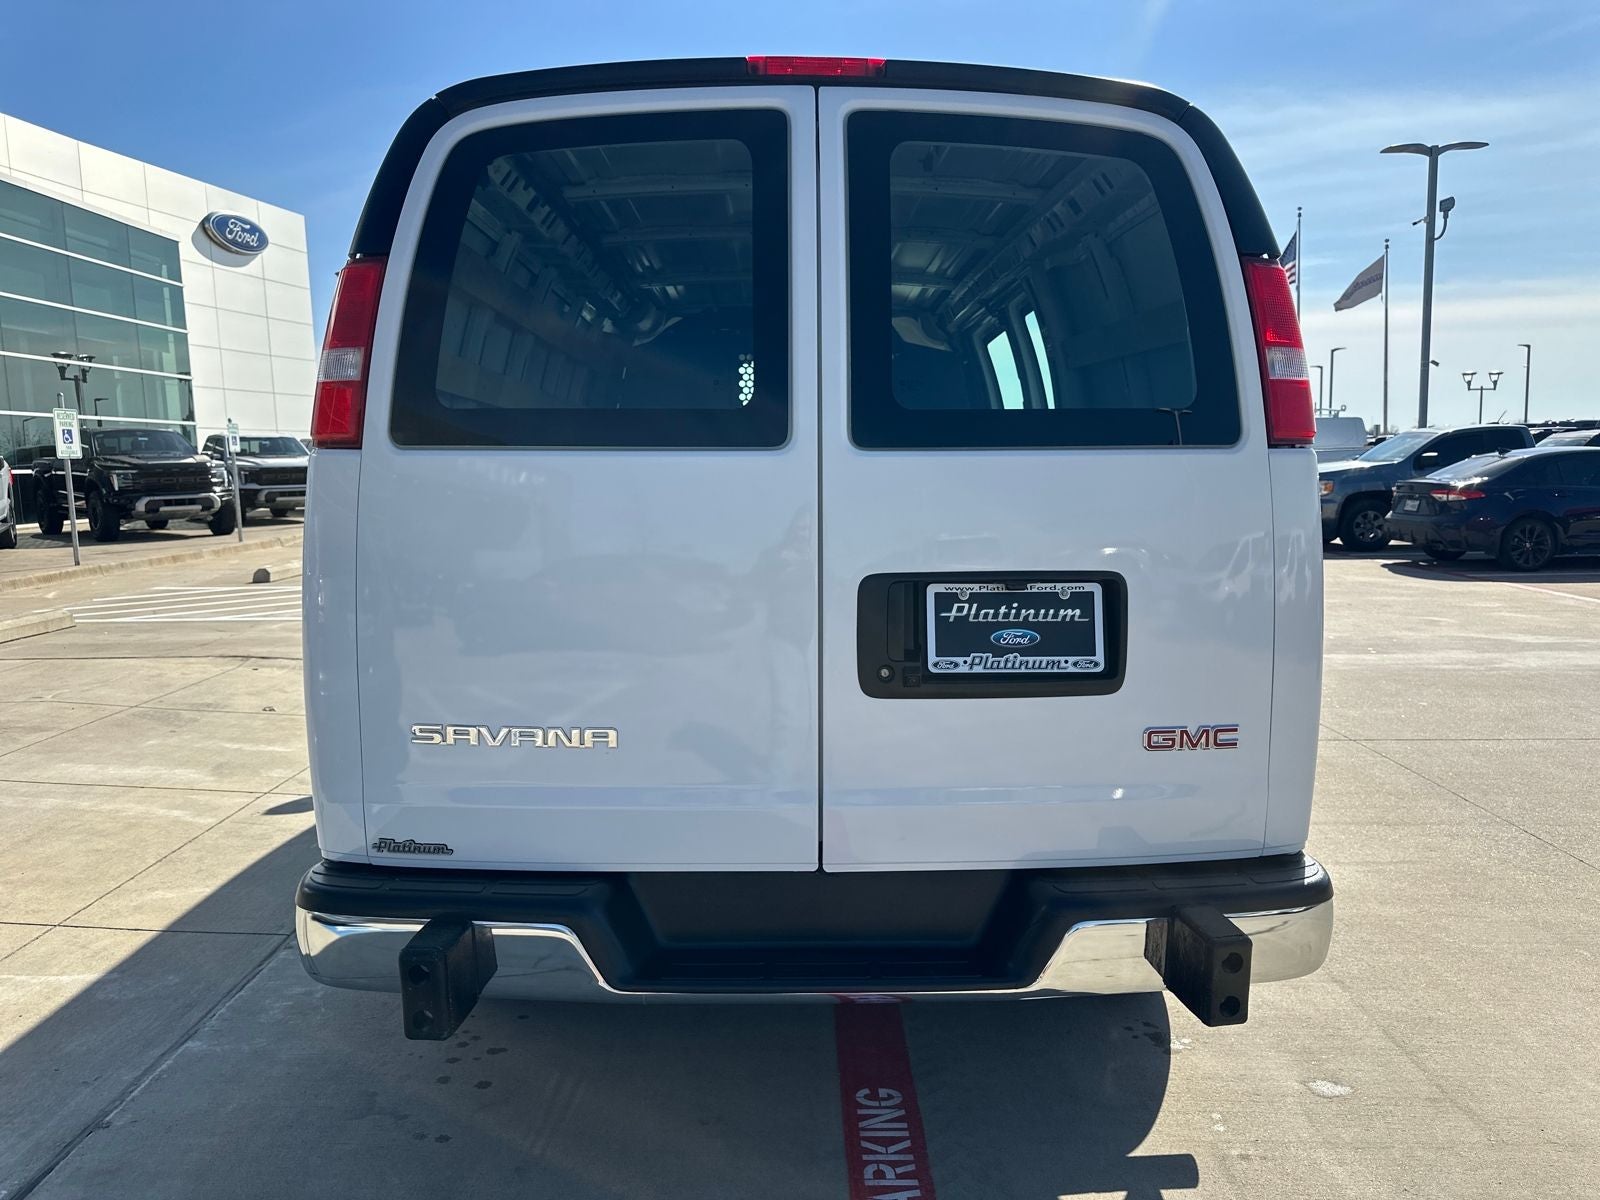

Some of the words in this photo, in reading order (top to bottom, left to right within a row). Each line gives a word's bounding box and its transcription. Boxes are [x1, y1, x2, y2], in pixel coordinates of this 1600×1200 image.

[226, 219, 259, 246] Ford
[939, 603, 1090, 622] Platinum
[1000, 631, 1030, 644] Ford
[968, 654, 1069, 671] Platinum
[411, 723, 618, 748] SAVANA
[1143, 724, 1239, 751] GMC
[372, 838, 453, 855] Platinum
